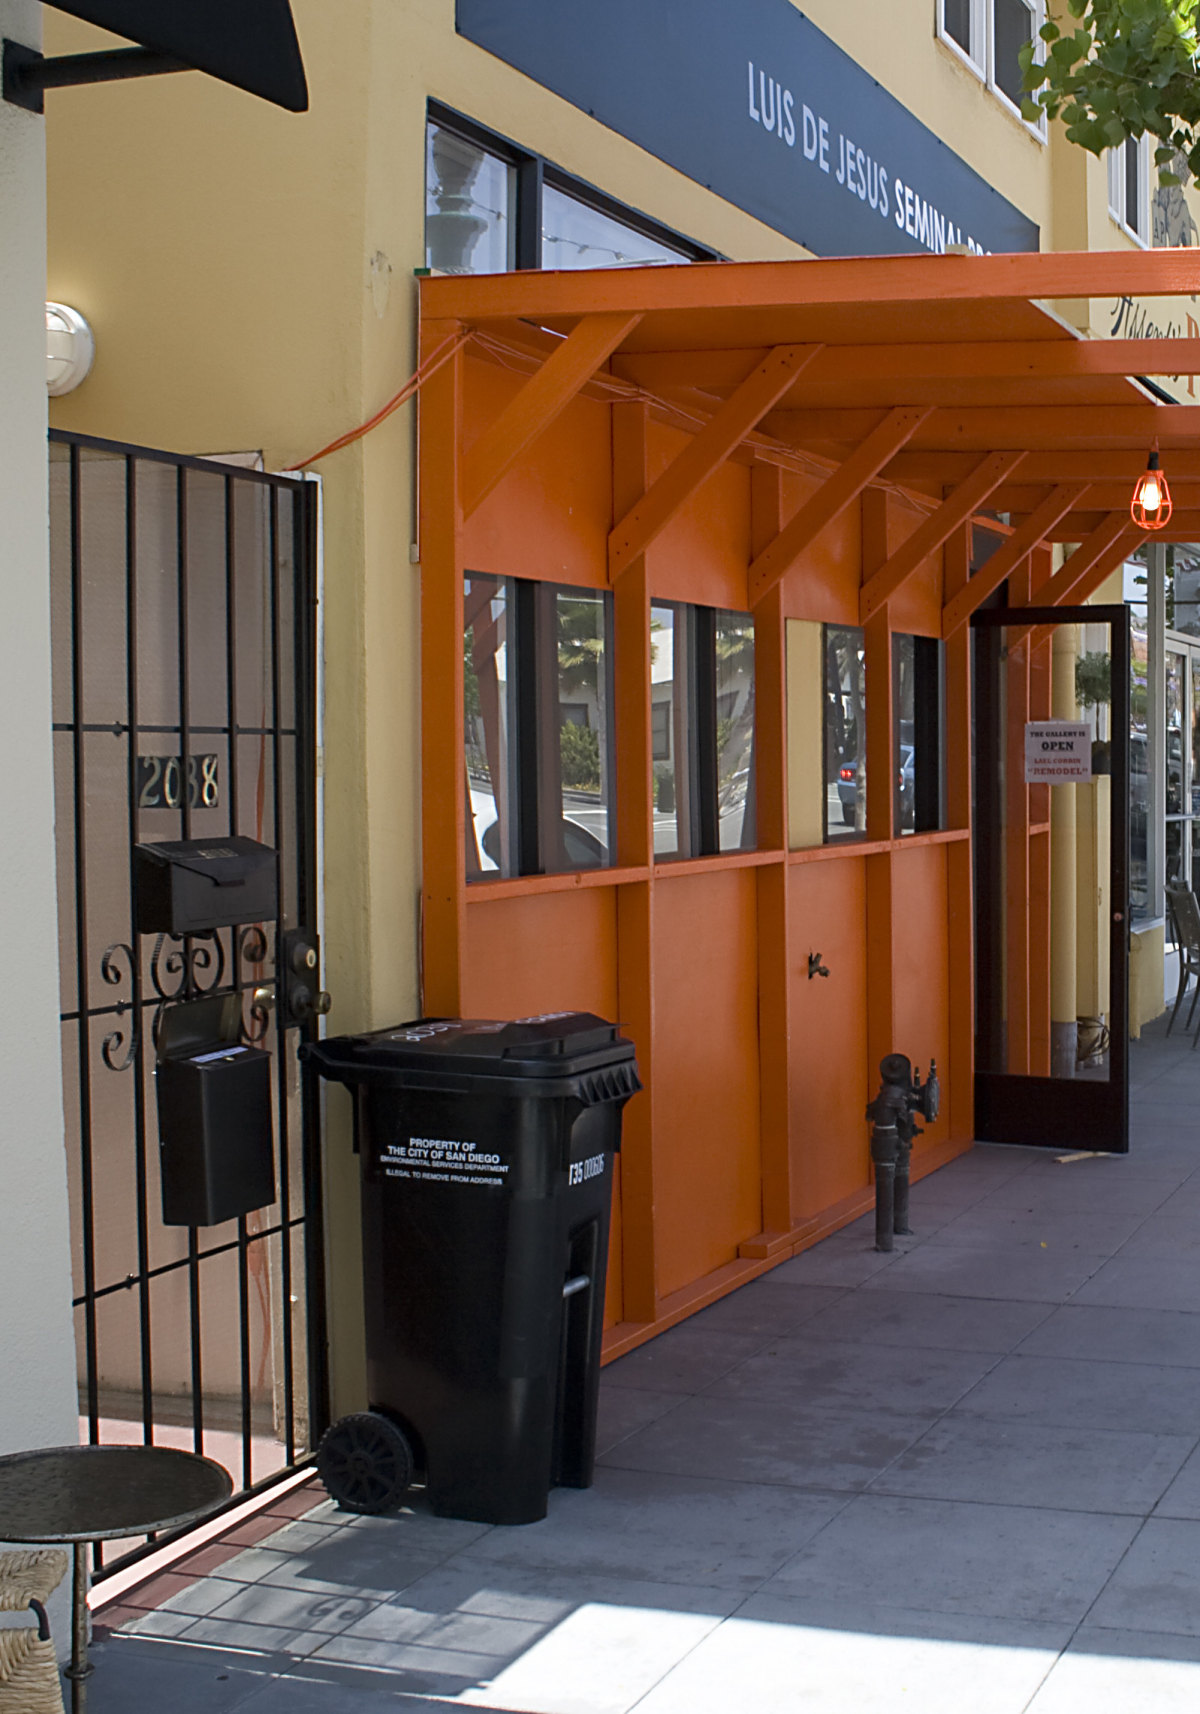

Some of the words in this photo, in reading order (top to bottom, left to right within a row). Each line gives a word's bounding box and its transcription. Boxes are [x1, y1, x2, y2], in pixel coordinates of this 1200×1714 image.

[749, 61, 795, 147] LUIS
[803, 103, 830, 174] DE
[836, 134, 889, 218] JESUS
[1042, 741, 1074, 751] OPEN
[409, 1137, 460, 1151] PROPERTY
[462, 1142, 477, 1152] OF
[387, 1145, 406, 1156] THE
[407, 1147, 430, 1159] CITY
[430, 1150, 444, 1160] OF
[445, 1151, 466, 1161] SAN
[468, 1153, 500, 1164] DIEGO
[380, 1155, 431, 1167] ENVIRONMENTAL
[431, 1160, 463, 1170] SERVICES
[464, 1163, 509, 1173] DEPARTMENT
[386, 1168, 411, 1178] ILLEGAL
[412, 1171, 421, 1179] TO
[422, 1172, 450, 1181] REMOVE
[450, 1174, 469, 1183] FROM
